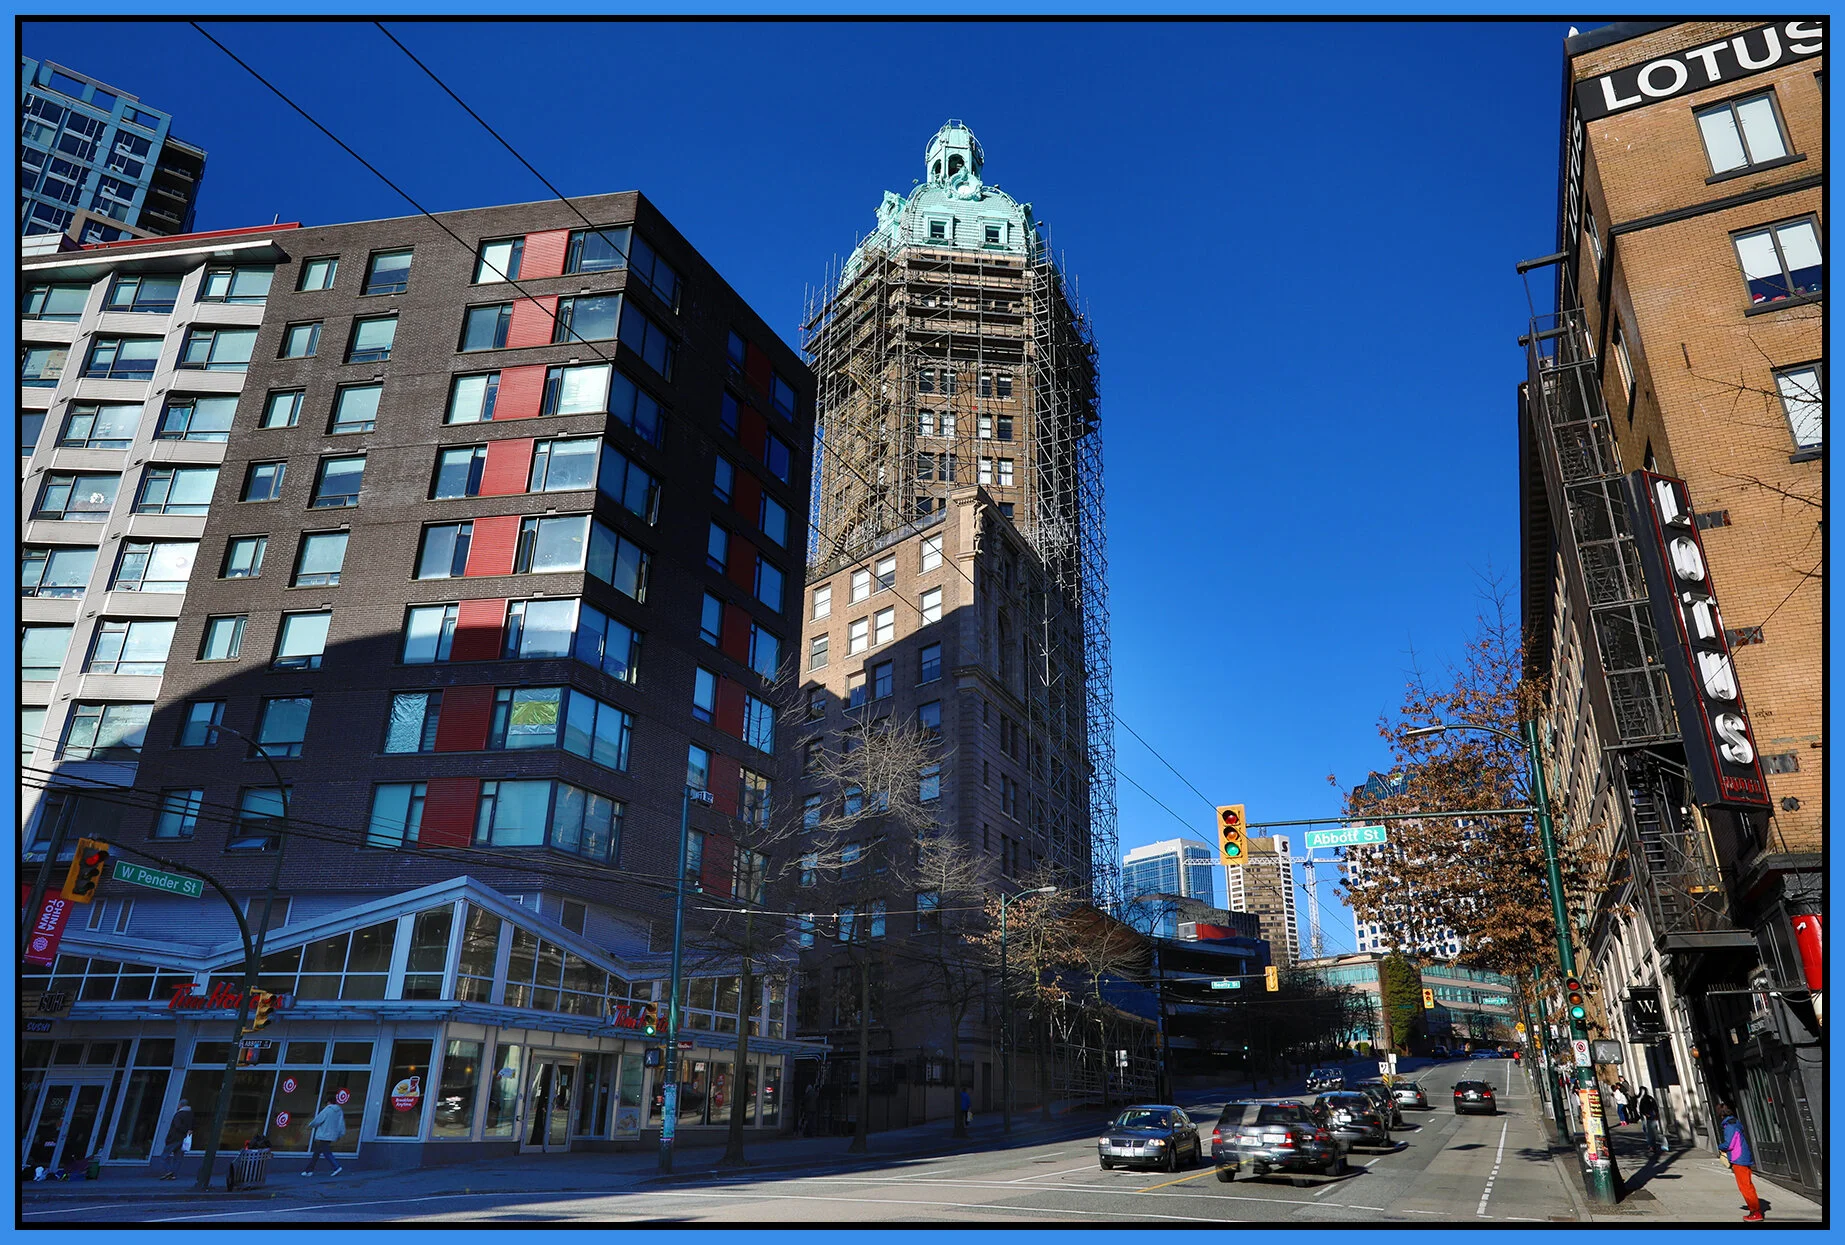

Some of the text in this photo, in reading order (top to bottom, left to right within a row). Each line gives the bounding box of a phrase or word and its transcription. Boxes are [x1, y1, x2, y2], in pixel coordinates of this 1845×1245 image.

[1600, 22, 1823, 111] LOTUS
[1569, 108, 1583, 245] LOTUS
[1656, 480, 1754, 764] LOTUS
[1313, 829, 1379, 845] Abbott St
[122, 866, 197, 893] W Pender St
[38, 899, 57, 930] TOWN
[46, 900, 64, 931] CHINA
[168, 983, 206, 1009] Tim
